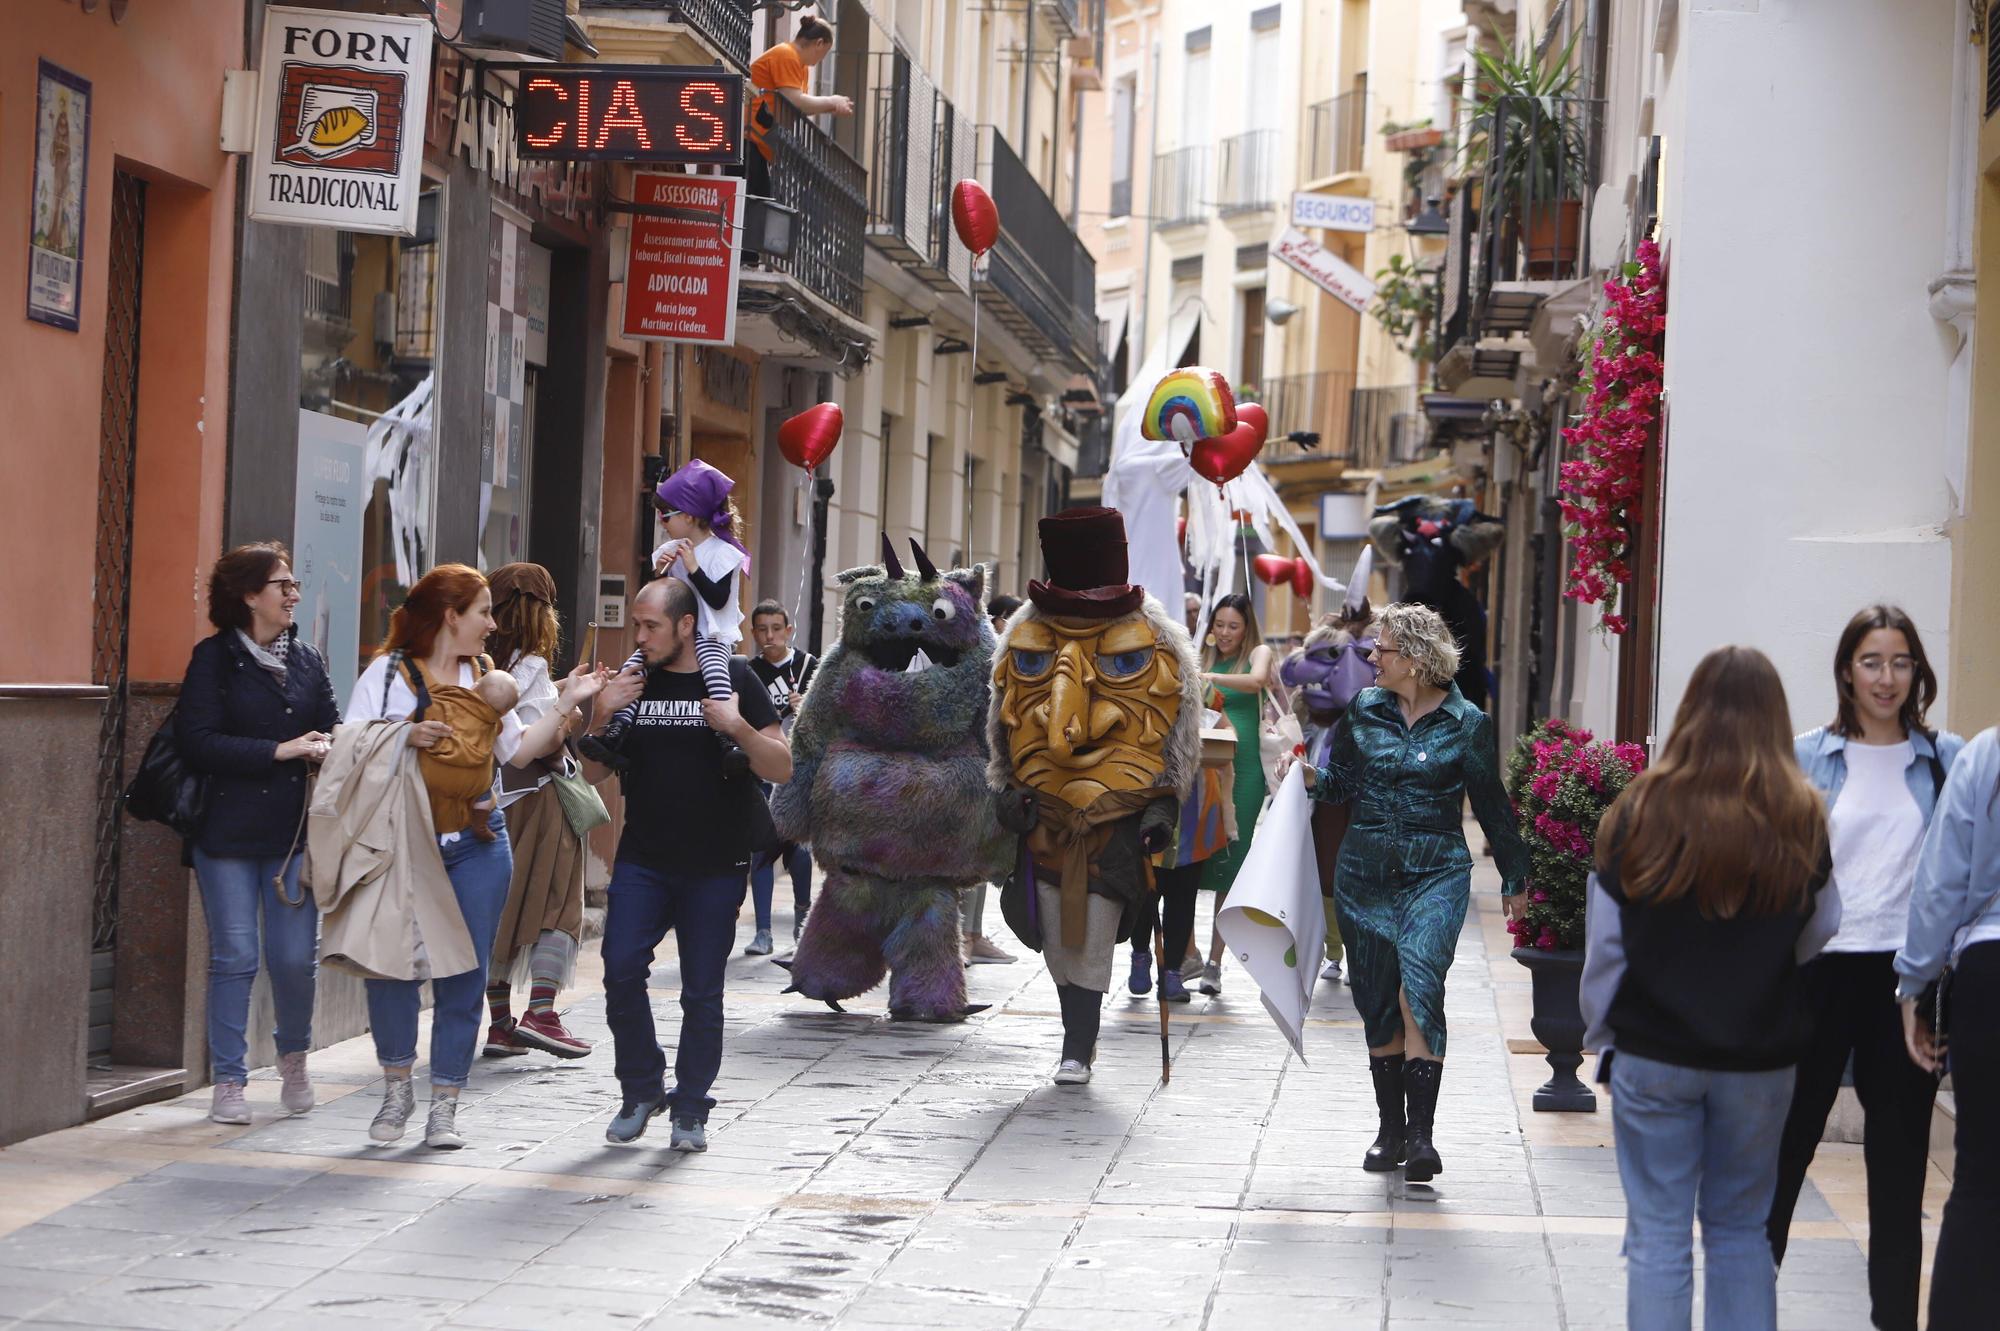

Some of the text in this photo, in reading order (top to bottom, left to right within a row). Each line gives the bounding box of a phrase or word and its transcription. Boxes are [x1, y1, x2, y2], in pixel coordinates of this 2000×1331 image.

[284, 26, 411, 64] FORN
[268, 173, 399, 212] TRADICIONAL
[653, 184, 718, 206] ASSESSORIA
[1295, 199, 1371, 225] SEGUROS
[643, 233, 694, 248] Assessorament
[635, 249, 662, 263] laboral,
[663, 251, 682, 264] fiscal
[687, 254, 726, 268] comptable.
[647, 273, 708, 296] ADVOCADA
[677, 303, 697, 317] Josep
